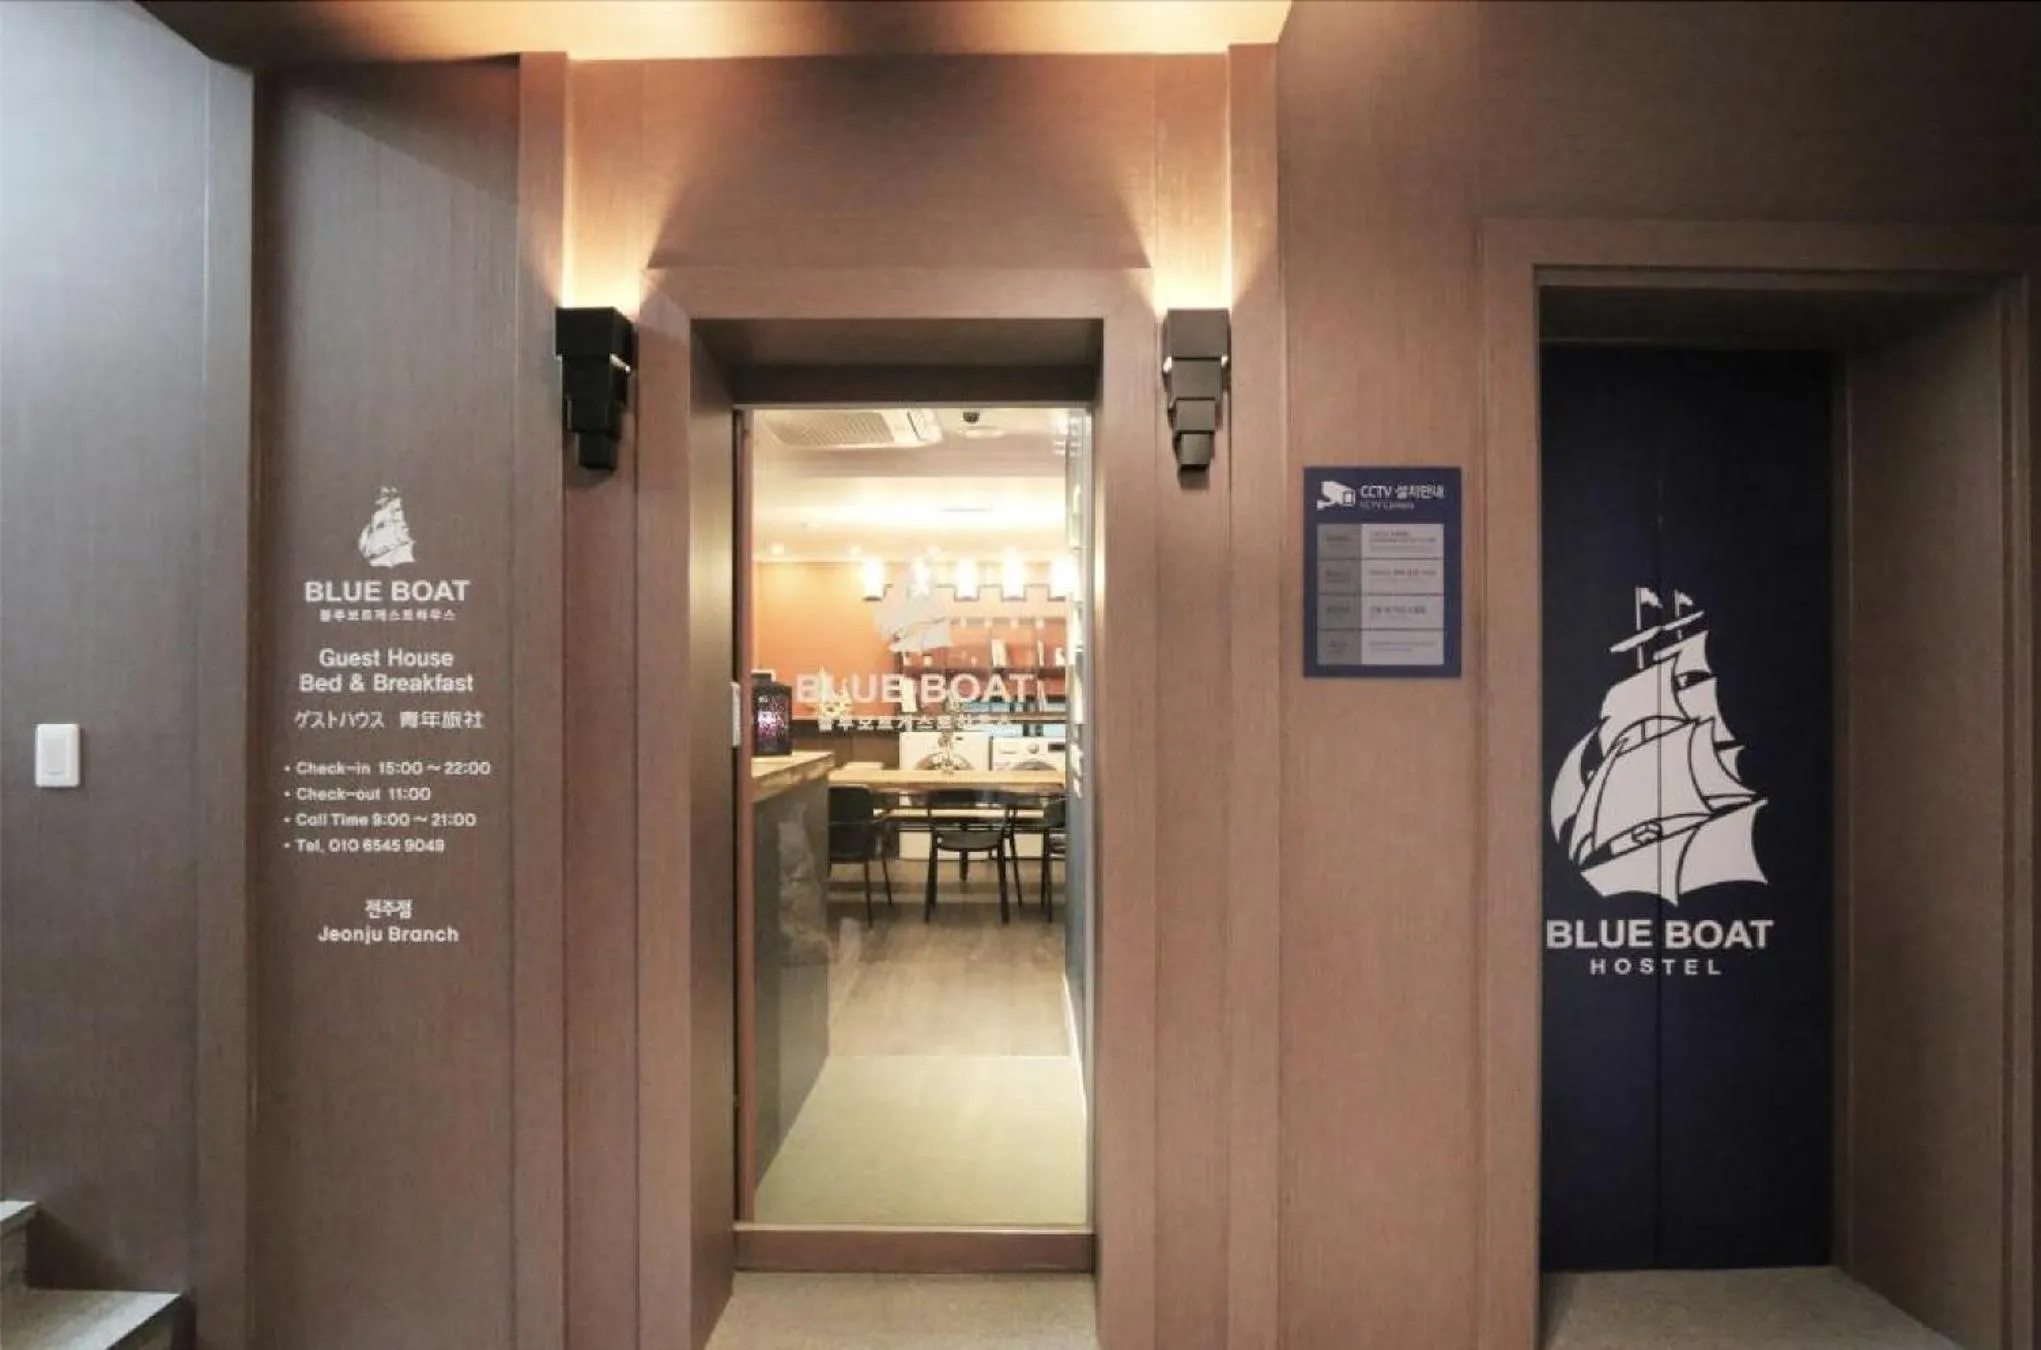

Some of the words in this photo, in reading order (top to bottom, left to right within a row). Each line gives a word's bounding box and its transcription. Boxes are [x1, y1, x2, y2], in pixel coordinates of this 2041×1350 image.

[1361, 485, 1392, 498] CCTV
[305, 580, 382, 602] BLUE
[391, 579, 471, 602] BOAT
[319, 648, 381, 667] Guest
[387, 648, 454, 667] House
[299, 673, 342, 692] Bed
[349, 673, 364, 692] &
[373, 673, 474, 692] Breakfast
[796, 673, 903, 703] BLUE
[920, 673, 1034, 703] BOAT
[294, 710, 385, 729] ゲストハウス
[295, 761, 371, 776] Check-in
[378, 761, 423, 776] 15:00
[443, 761, 491, 776] 22:00
[295, 787, 381, 801] Check-out
[388, 787, 431, 801] 11:00
[295, 813, 328, 827] Call
[331, 813, 369, 827] Time
[431, 812, 477, 827] 21:00
[328, 838, 359, 853] 010
[318, 924, 383, 945] Jeonju
[388, 924, 459, 942] Branch
[1545, 919, 1654, 951] BLUE
[1664, 919, 1775, 951] BOAT
[1589, 956, 1722, 976] HOSTEL
